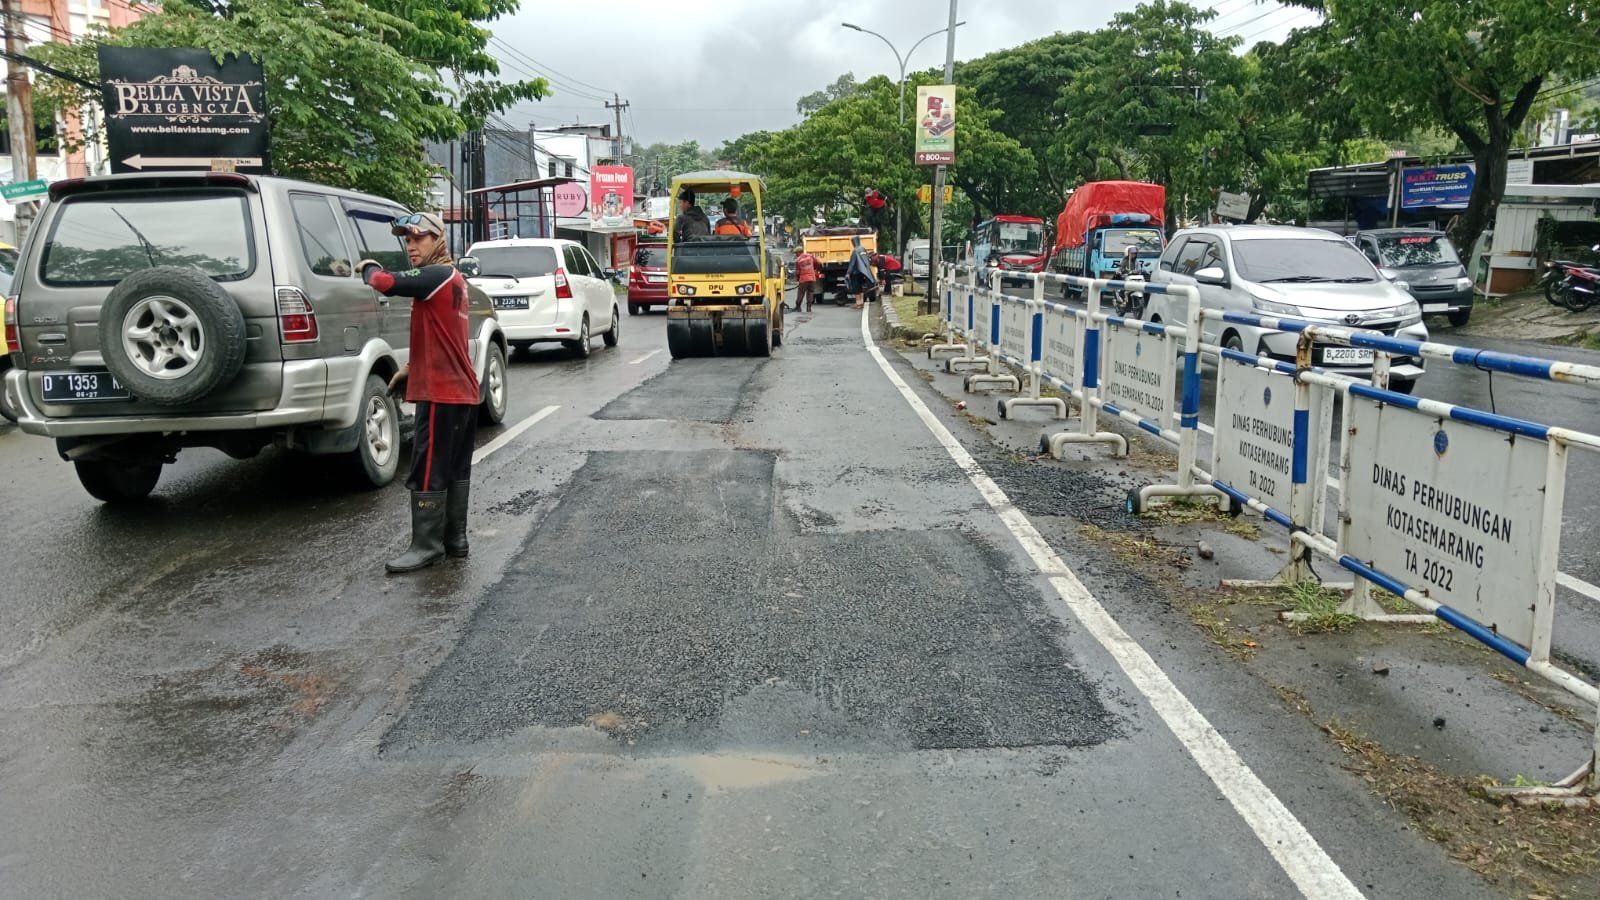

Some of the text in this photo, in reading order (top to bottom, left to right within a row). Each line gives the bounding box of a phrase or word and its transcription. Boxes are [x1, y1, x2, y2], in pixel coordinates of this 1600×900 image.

[116, 84, 257, 114] BELLA VISTA
[141, 103, 229, 114] REGENCY
[556, 193, 582, 201] RUBY
[43, 375, 53, 392] D
[67, 375, 98, 391] 1353
[1232, 413, 1295, 449] DINAS PERHUBUNG
[1239, 440, 1289, 476] KOTASEMARANG
[1249, 470, 1275, 497] TA 2022
[1372, 463, 1512, 544] DINAS PERHUBUNGAN
[1386, 503, 1484, 569] KOTASEMARANG
[1405, 548, 1453, 592] TA 2022
